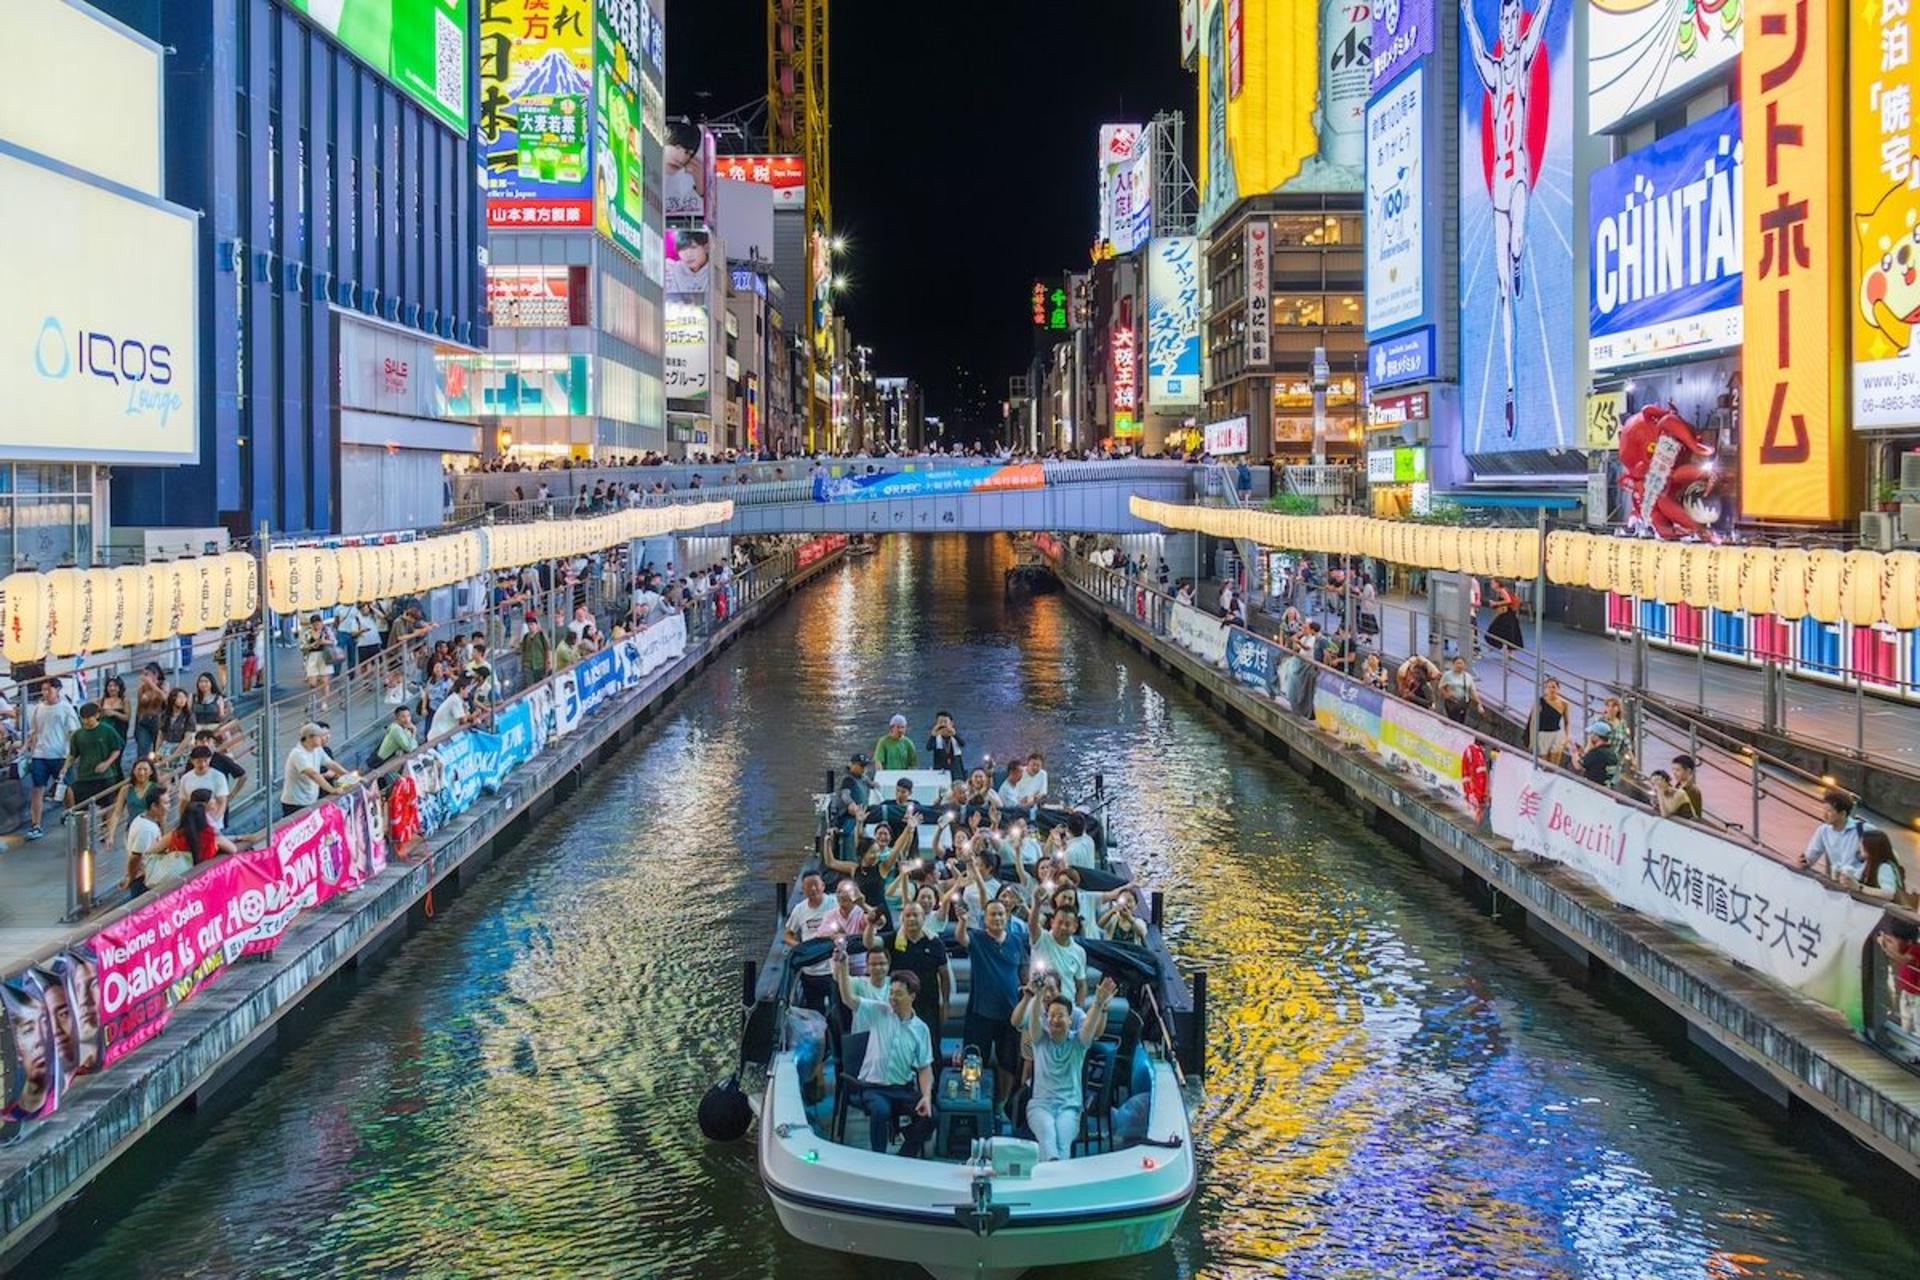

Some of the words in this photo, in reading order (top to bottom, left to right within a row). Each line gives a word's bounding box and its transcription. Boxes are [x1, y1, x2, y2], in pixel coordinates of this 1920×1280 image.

[521, 114, 577, 134] 大麦若葉
[1503, 87, 1515, 180] グリコ
[493, 207, 581, 223] 山本漢方製薬
[79, 331, 172, 385] IQOS
[385, 357, 407, 377] SALE
[1641, 847, 1823, 968] 大阪樟蔭女子大学
